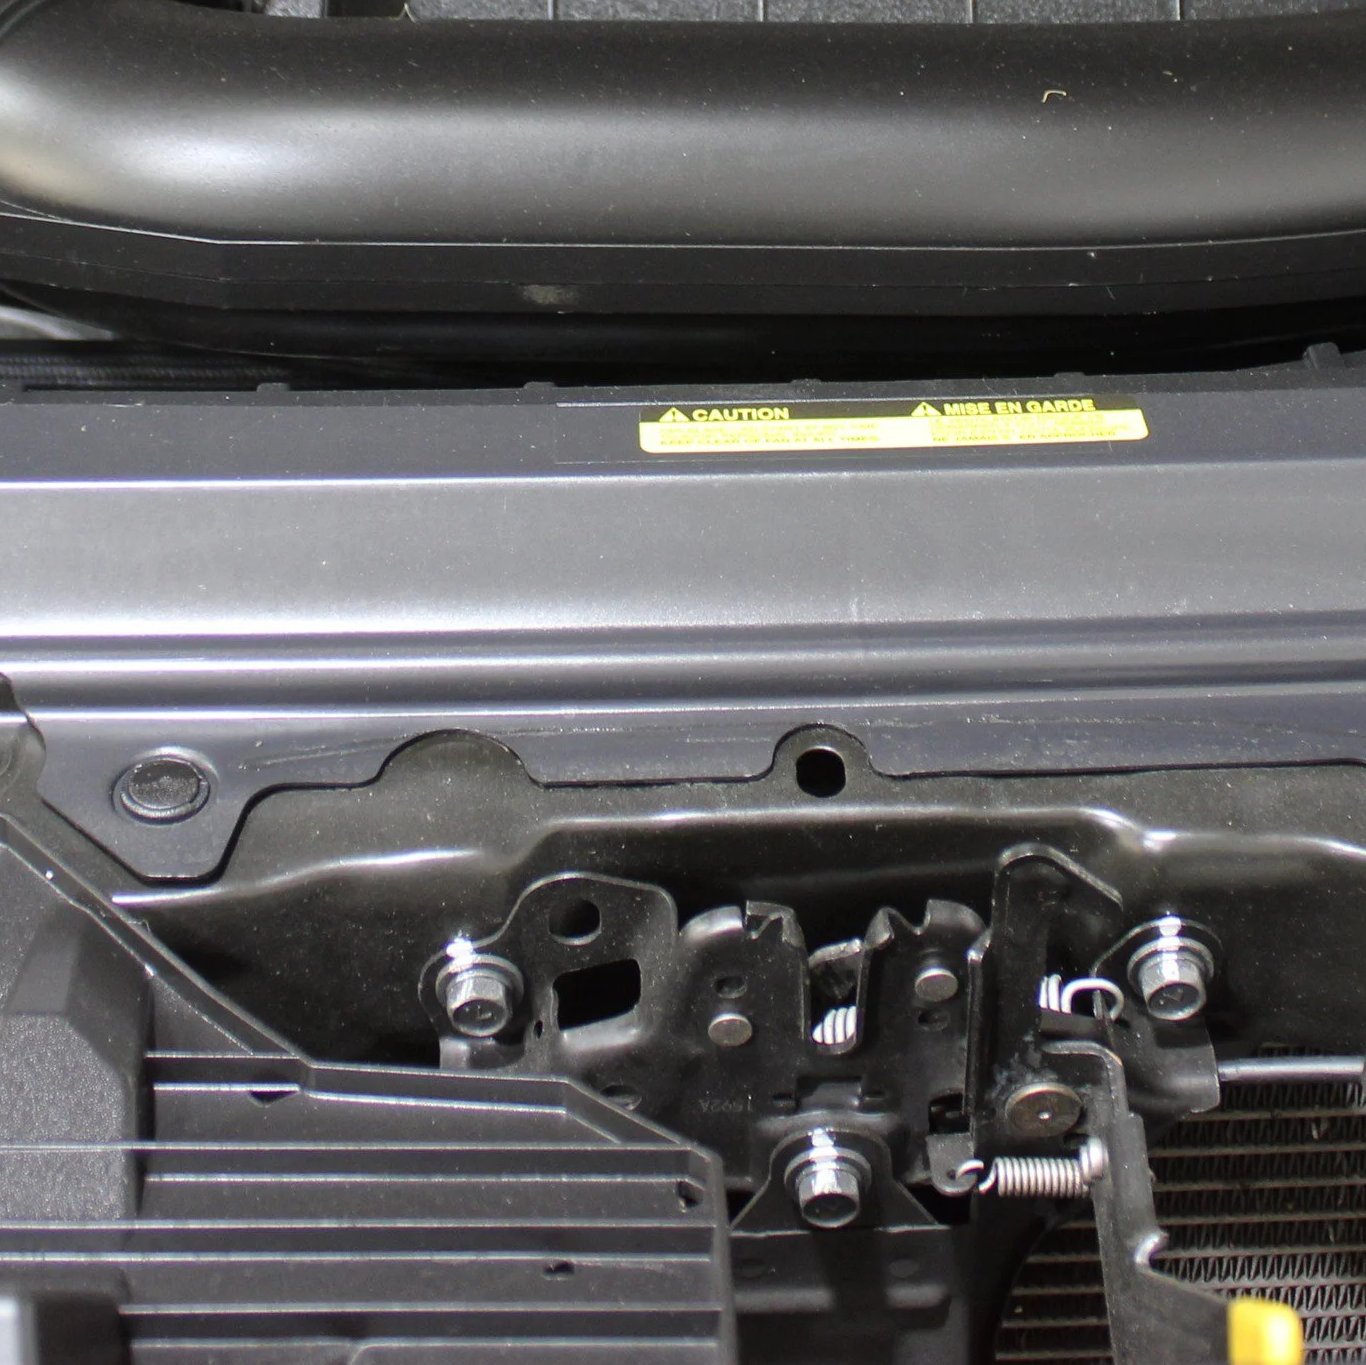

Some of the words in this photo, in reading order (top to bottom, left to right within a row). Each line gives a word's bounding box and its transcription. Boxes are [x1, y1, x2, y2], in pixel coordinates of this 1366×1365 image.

[692, 407, 790, 422] CAUTION
[943, 401, 992, 416] MISE
[994, 400, 1023, 414] EN
[1025, 398, 1097, 413] GARDE
